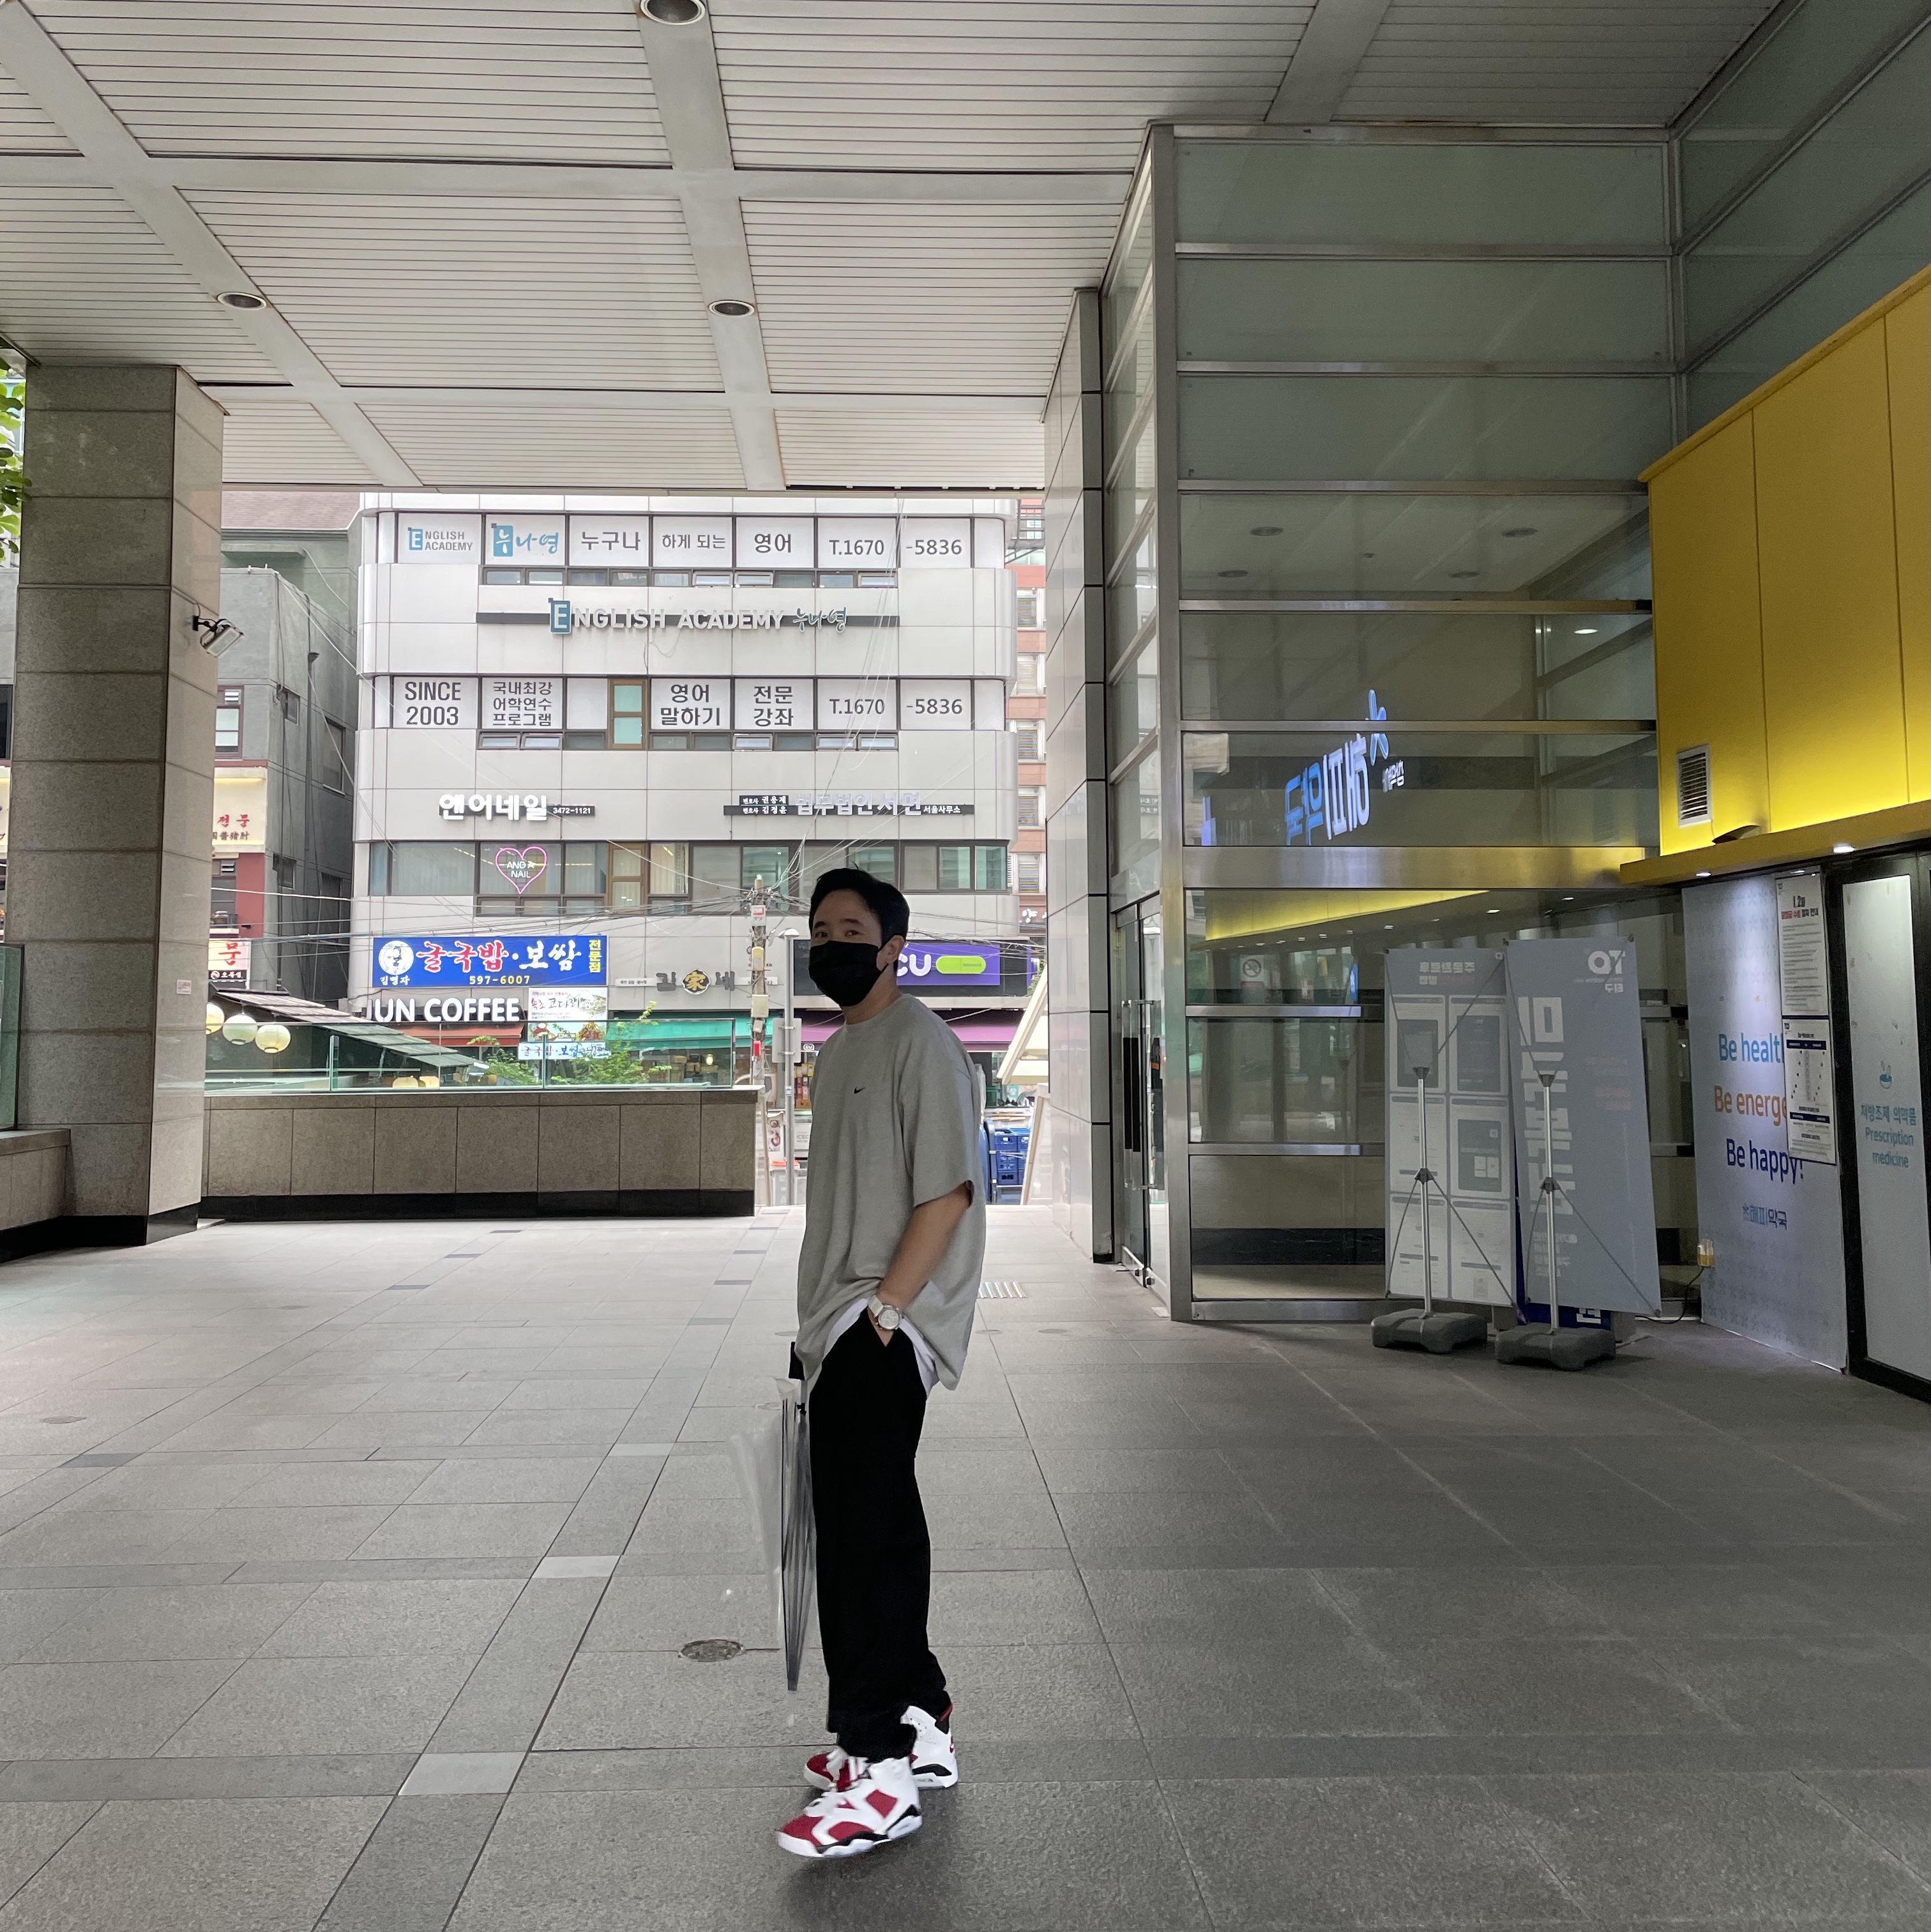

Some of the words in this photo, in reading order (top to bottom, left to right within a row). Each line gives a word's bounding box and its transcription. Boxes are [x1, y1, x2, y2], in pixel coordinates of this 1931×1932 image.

[425, 542, 473, 551] ACADEMY
[581, 531, 641, 551] 누구나
[662, 534, 690, 549] 하게
[697, 534, 726, 549] 되는
[754, 533, 791, 553] 영어
[829, 539, 884, 556] T.1670
[906, 539, 962, 555] -5836
[551, 600, 665, 633] ENGLISH
[677, 609, 785, 629] ACADEMY
[405, 681, 461, 701] SINCE
[493, 681, 552, 696] 국내최강
[670, 684, 709, 703] 영어
[753, 685, 793, 704] 전문
[493, 697, 552, 711] 어학연수
[829, 699, 885, 715] T.1670
[906, 698, 962, 715] -5836
[406, 706, 458, 726] 2003
[492, 713, 551, 727] 프로그램
[660, 707, 720, 726] 말하기
[753, 708, 794, 727] 강좌
[795, 793, 873, 816] 법무법인
[923, 805, 961, 814] 서울사무소
[506, 861, 526, 869] AND
[511, 870, 531, 879] NAIL
[588, 939, 602, 973] 전문점
[469, 975, 530, 985] 597-6007
[424, 998, 520, 1023] COFFEE
[1718, 1033, 1738, 1061] Be
[1741, 1032, 1783, 1064] healt
[1714, 1085, 1732, 1114] Be
[1865, 1126, 1914, 1147] Prescription
[1726, 1138, 1745, 1168] Be
[1872, 1151, 1909, 1168] medicine
